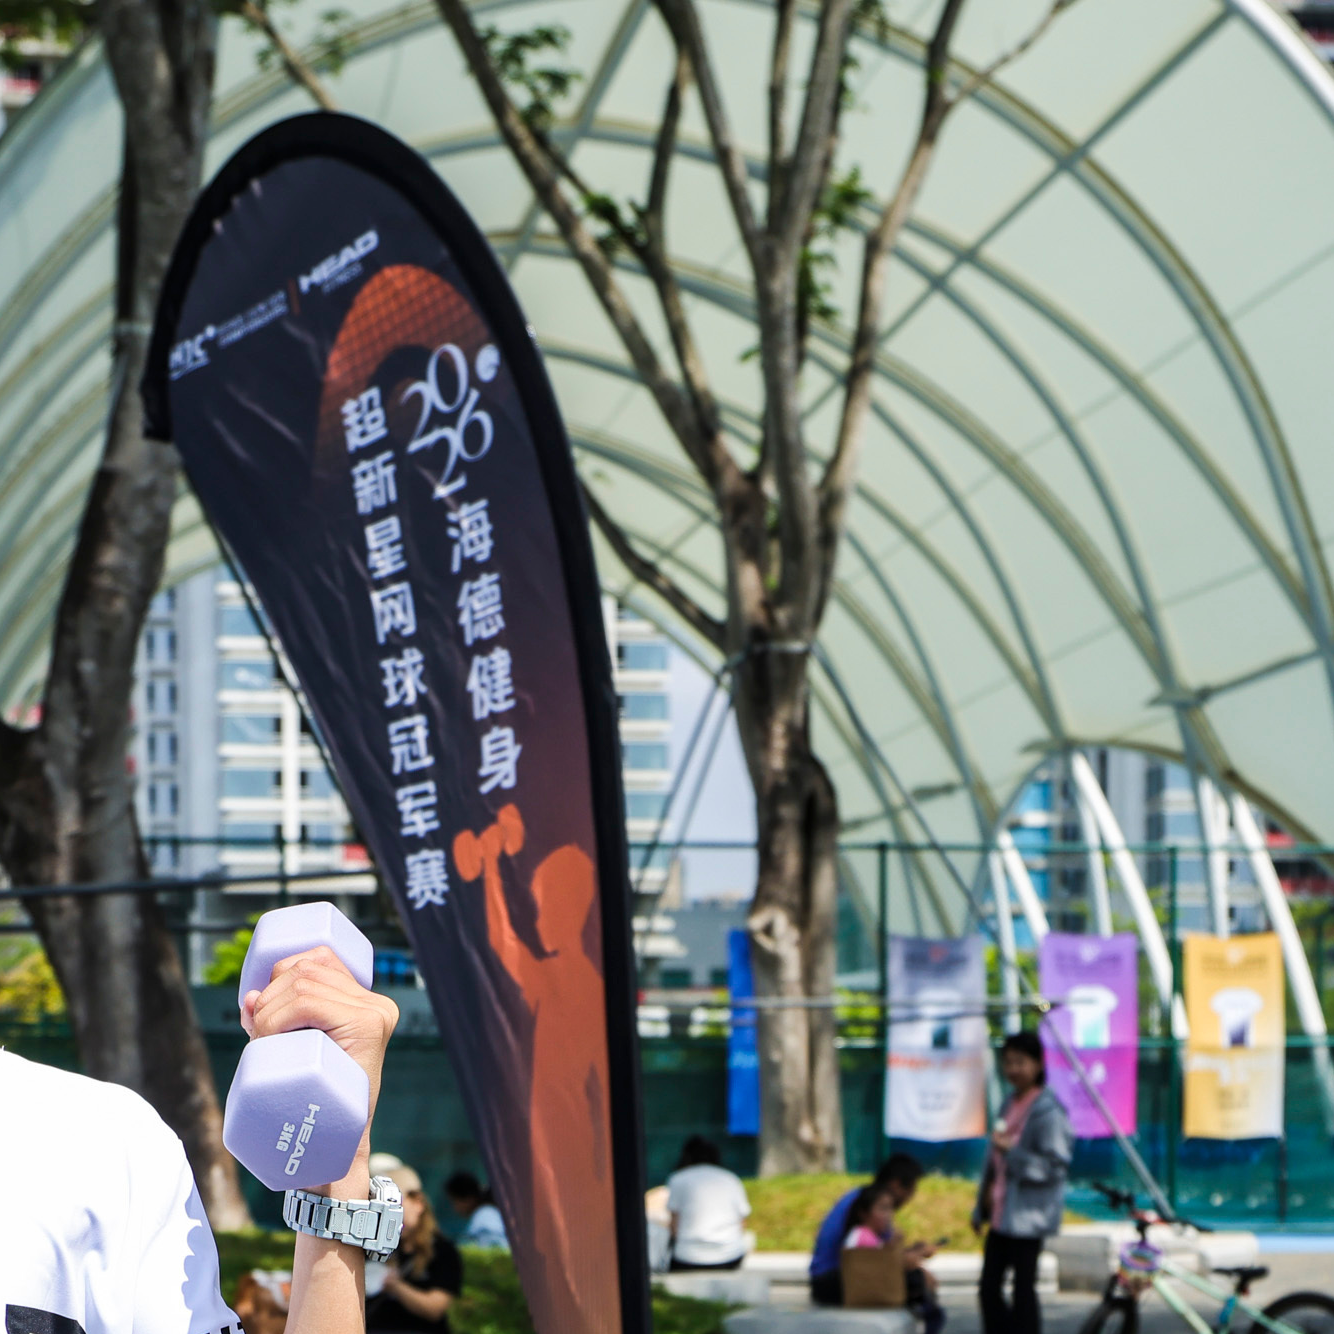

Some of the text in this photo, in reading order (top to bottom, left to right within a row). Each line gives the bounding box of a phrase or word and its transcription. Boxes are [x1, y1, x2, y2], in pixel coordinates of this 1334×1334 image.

[341, 386, 450, 910] 超新星网球冠军赛
[446, 498, 522, 796] 海德健身
[275, 1121, 296, 1152] 3KG
[284, 1103, 321, 1176] HEAD
